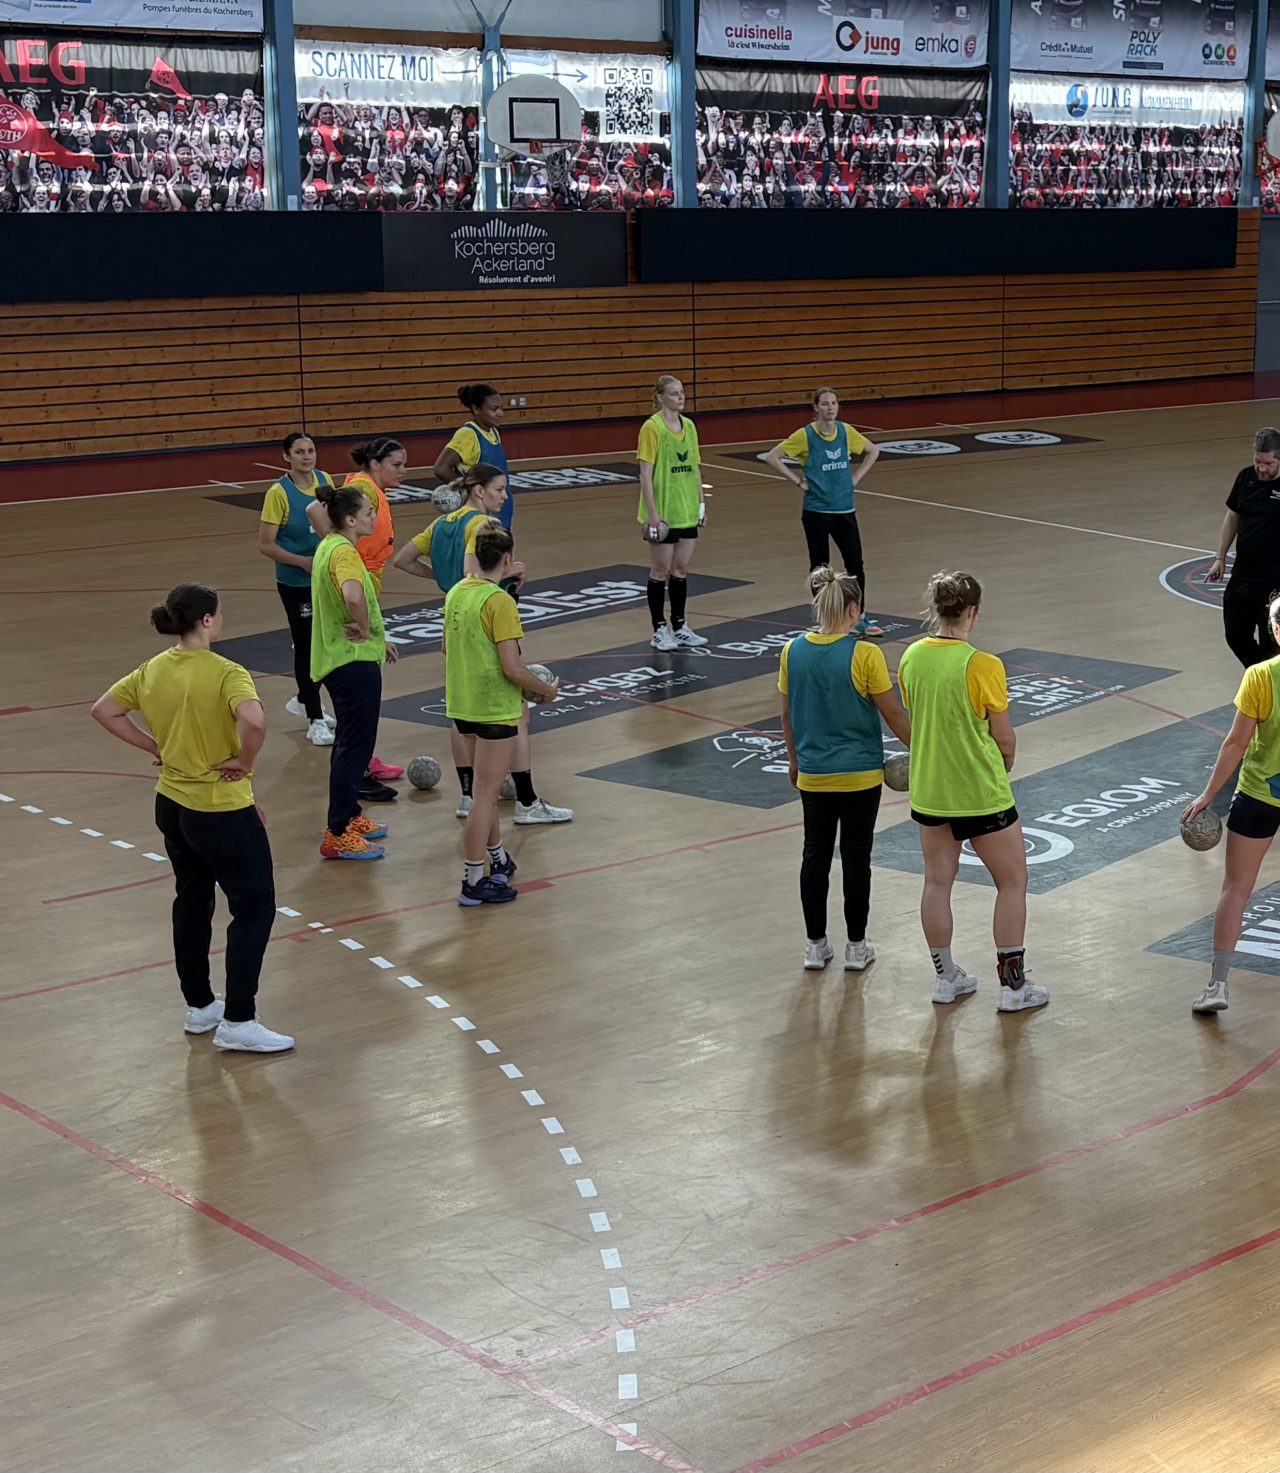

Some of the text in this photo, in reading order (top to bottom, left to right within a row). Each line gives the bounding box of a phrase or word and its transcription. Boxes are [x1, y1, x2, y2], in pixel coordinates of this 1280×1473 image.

[143, 3, 171, 13] Pompes
[213, 7, 253, 17] Kochersberg
[725, 24, 793, 41] cuisinella
[1130, 30, 1161, 43] POLY
[864, 31, 900, 56] jung
[915, 32, 959, 54] emka
[1070, 43, 1094, 54] Mutuel
[1127, 44, 1159, 57] RACK
[311, 50, 434, 82] SCANNEZ MOI
[812, 72, 880, 110] AEG
[1092, 86, 1132, 108] JUNG
[454, 238, 556, 261] Kochersberg
[471, 256, 546, 274] Ackerland
[479, 275, 522, 284] Résolument
[671, 464, 693, 474] erima
[821, 460, 848, 473] erima
[1017, 686, 1084, 707] LAIT
[539, 704, 586, 718] GAZ
[1034, 776, 1183, 828] EQIOM
[1138, 791, 1197, 818] COMPANY
